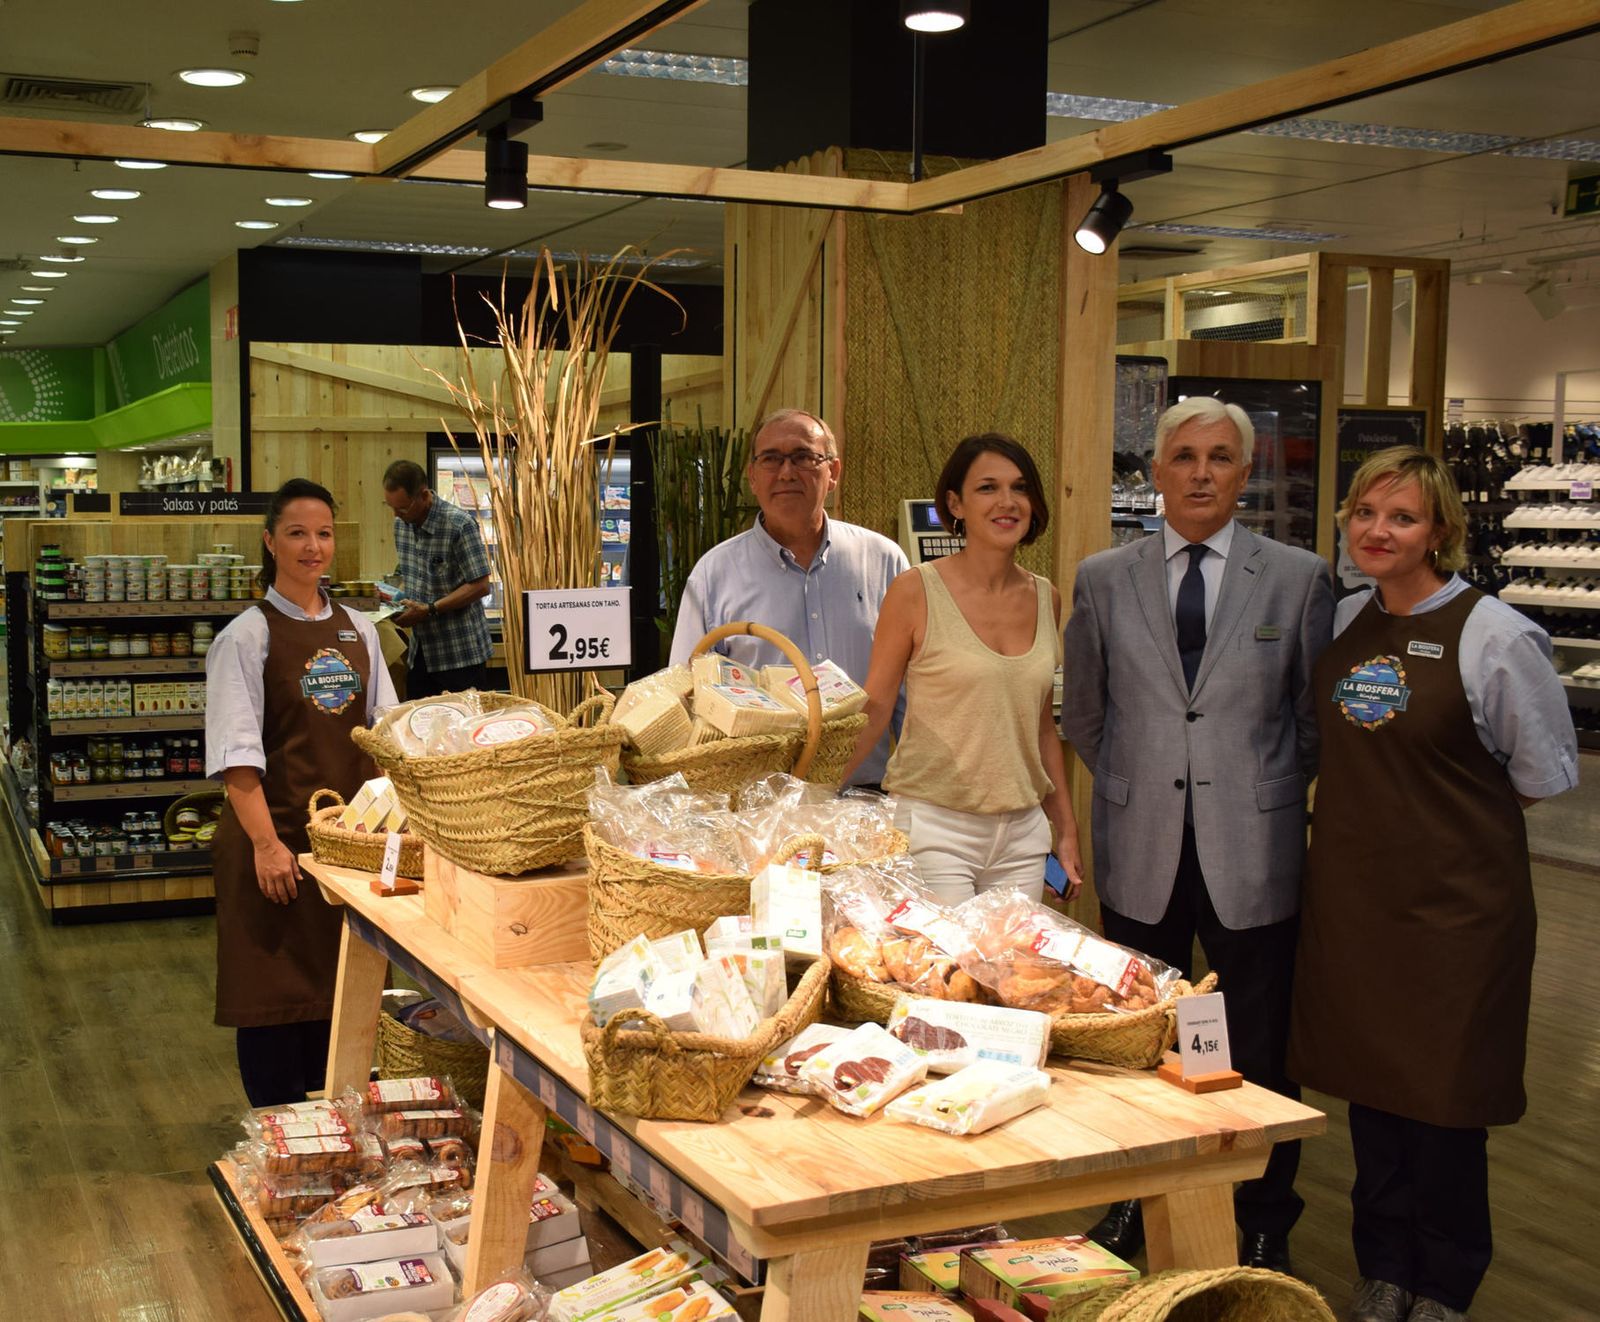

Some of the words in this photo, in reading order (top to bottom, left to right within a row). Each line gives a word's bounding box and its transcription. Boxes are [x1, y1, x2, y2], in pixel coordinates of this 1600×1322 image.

[162, 497, 195, 511] Salsas
[199, 500, 206, 513] y
[210, 497, 239, 513] patés
[536, 602, 557, 610] TORTAS
[558, 601, 591, 609] ARTESANAS
[591, 600, 603, 608] CON
[548, 623, 610, 664] 2,95€
[306, 678, 318, 686] LA
[318, 674, 354, 684] BIOSFERA
[1343, 682, 1354, 691] LA
[1356, 683, 1400, 697] BIOSFERA
[1191, 1033, 1219, 1056] 4,15€
